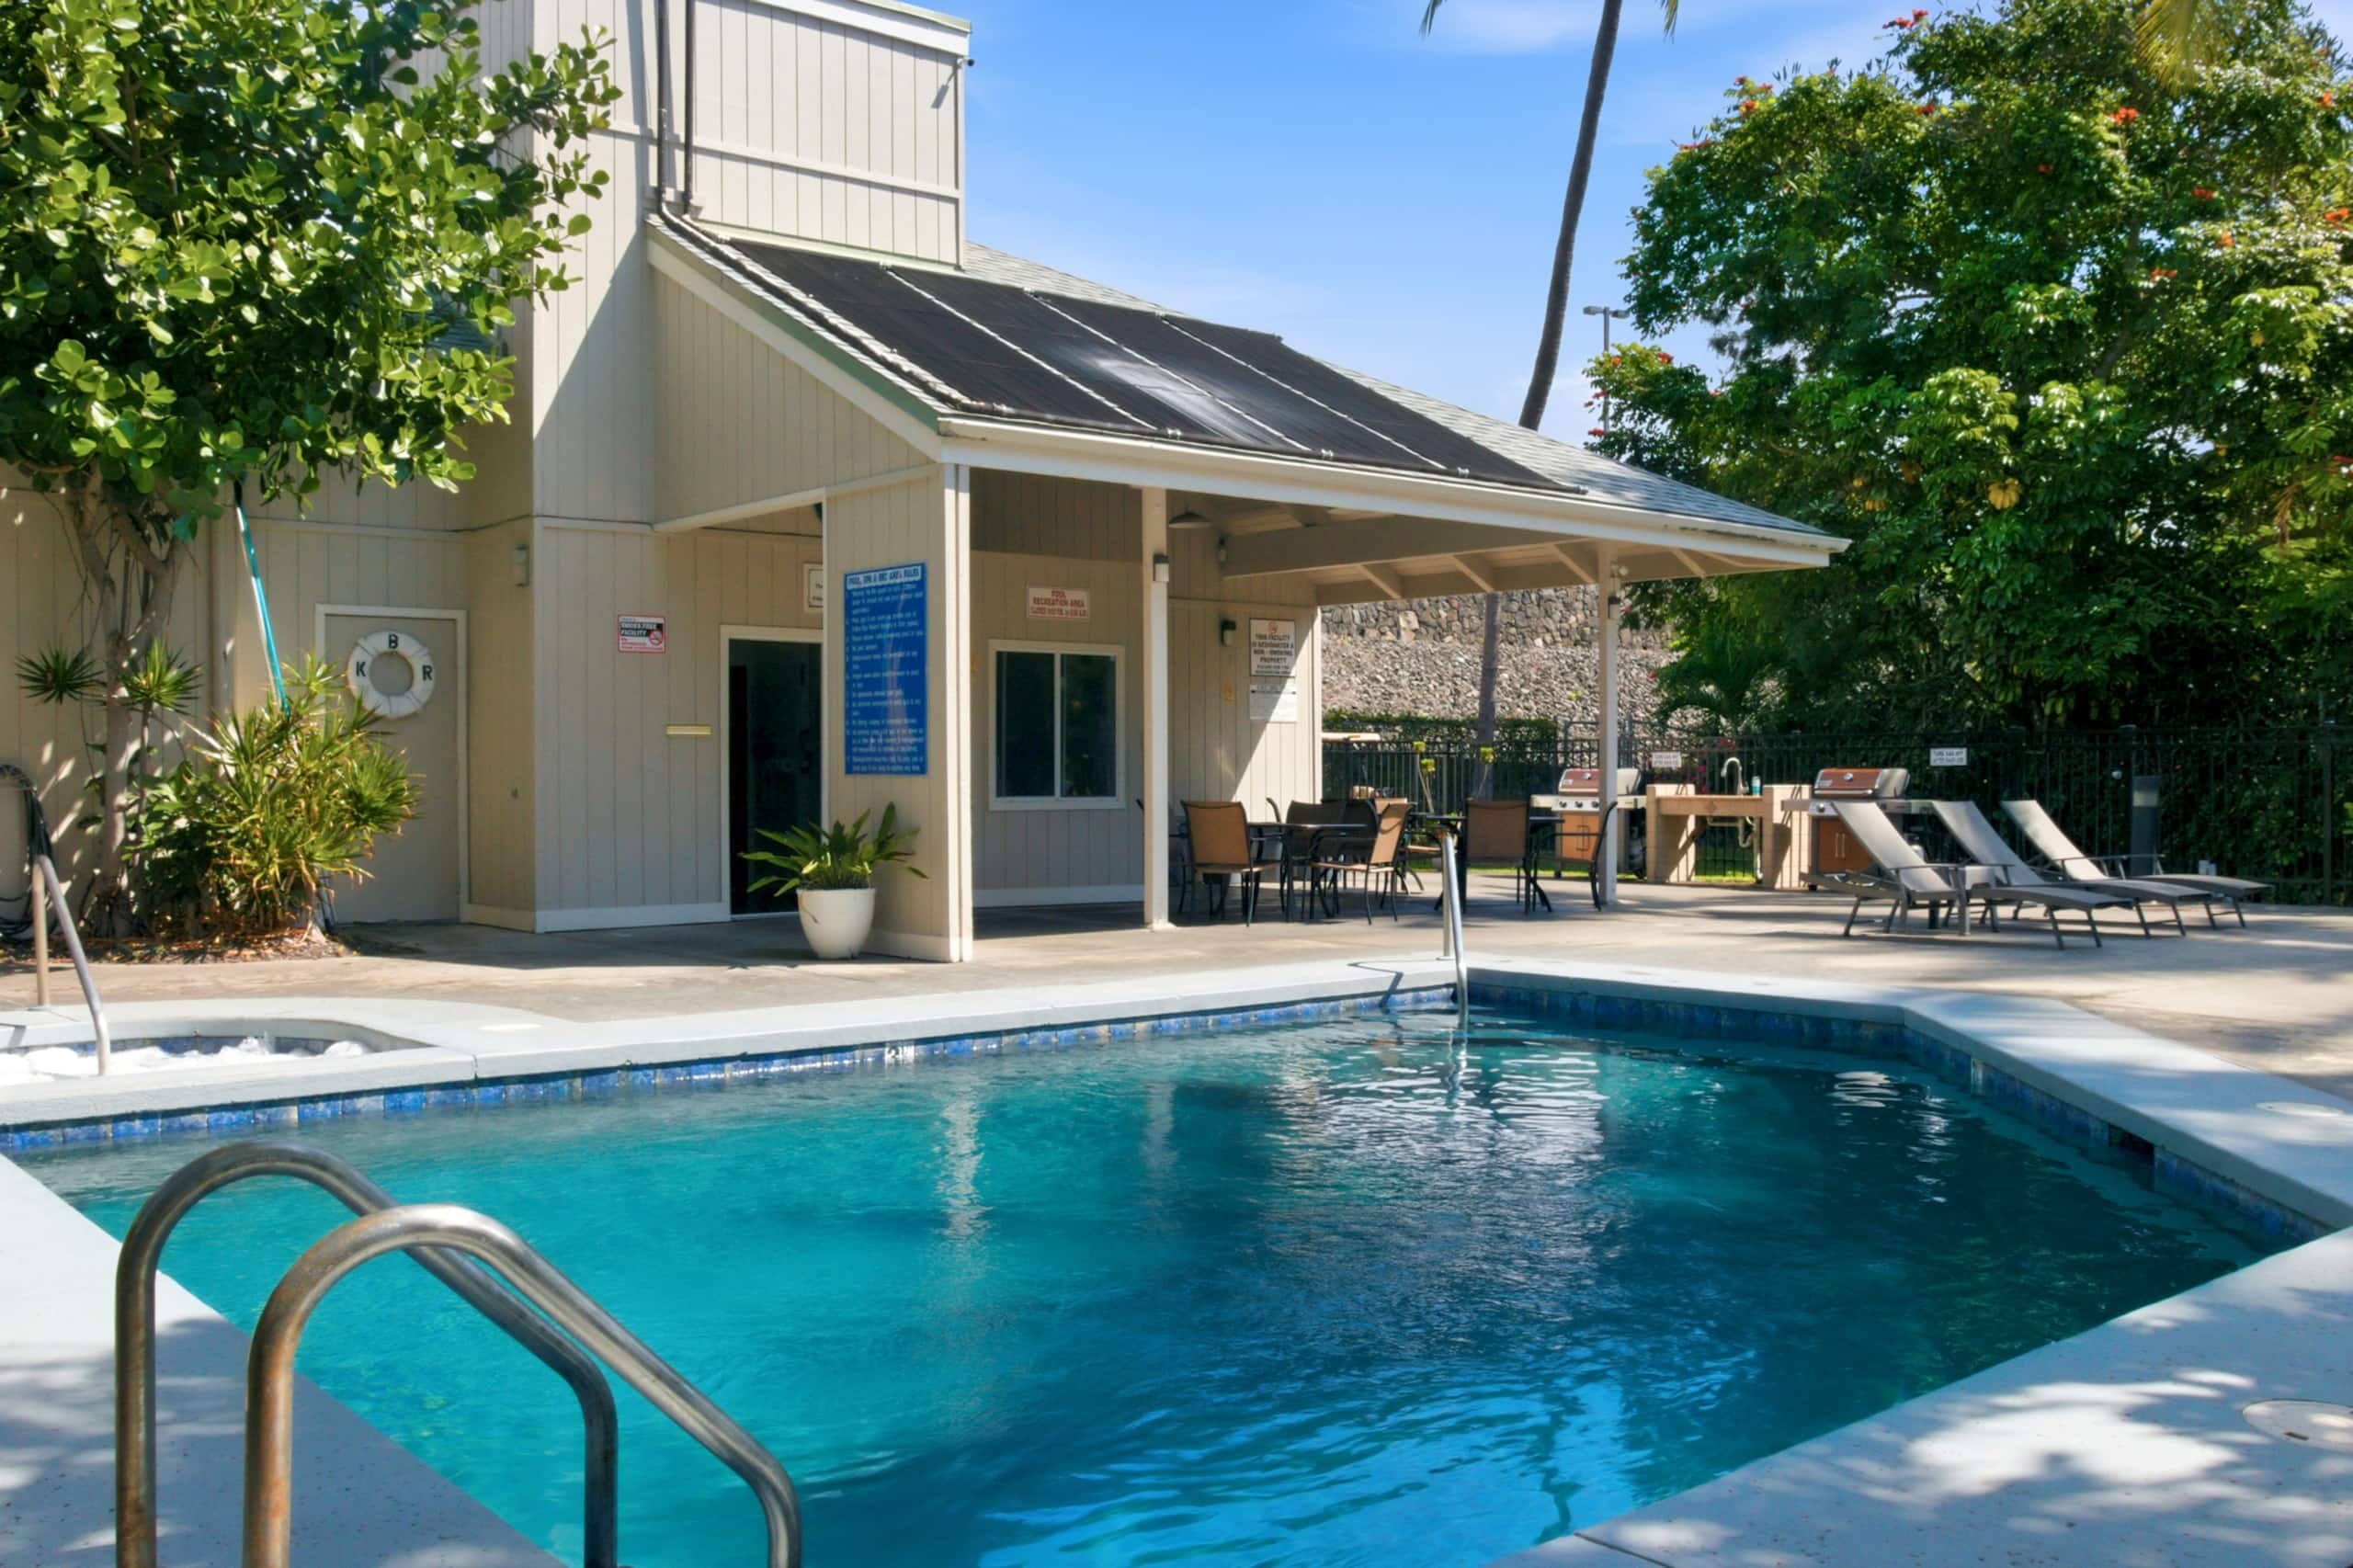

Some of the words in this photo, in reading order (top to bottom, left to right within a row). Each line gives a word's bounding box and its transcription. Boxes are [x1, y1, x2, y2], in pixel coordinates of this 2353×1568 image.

[389, 633, 399, 649] B
[356, 661, 367, 676] K
[422, 665, 433, 680] R
